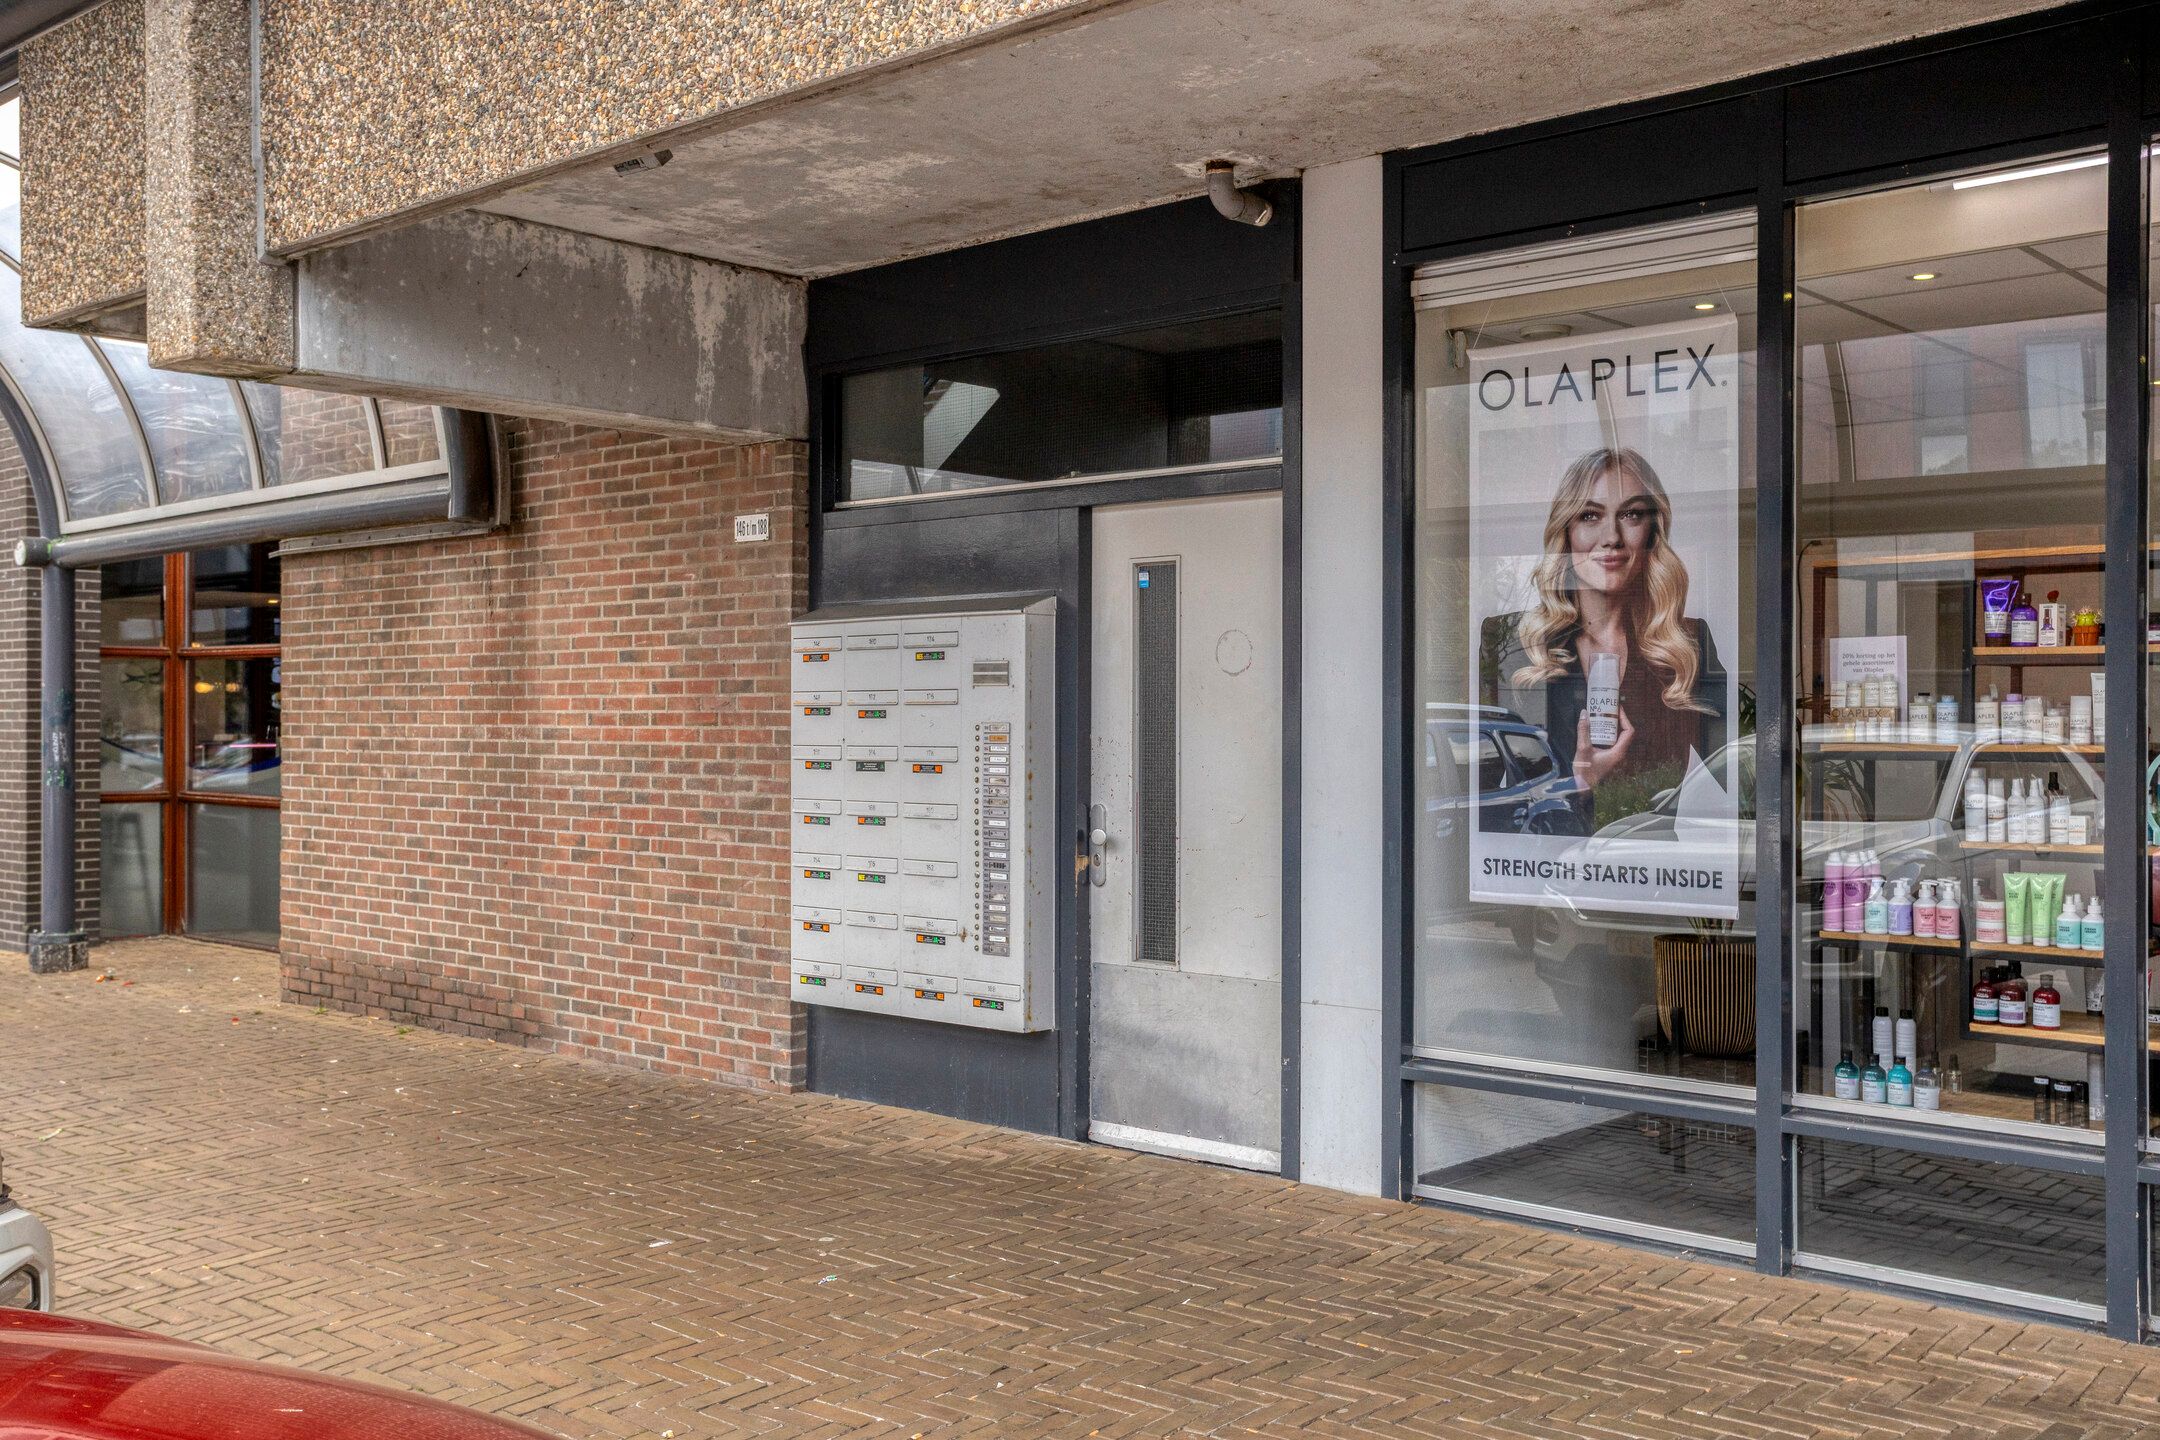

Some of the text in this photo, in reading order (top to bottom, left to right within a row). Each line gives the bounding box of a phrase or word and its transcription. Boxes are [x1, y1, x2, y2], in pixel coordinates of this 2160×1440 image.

[757, 518, 767, 535] 188
[1589, 697, 1618, 707] OLAPLE
[1831, 708, 1881, 718] OLAPLEX
[1483, 857, 1723, 889] STRENGTH STARTS INSIDE
